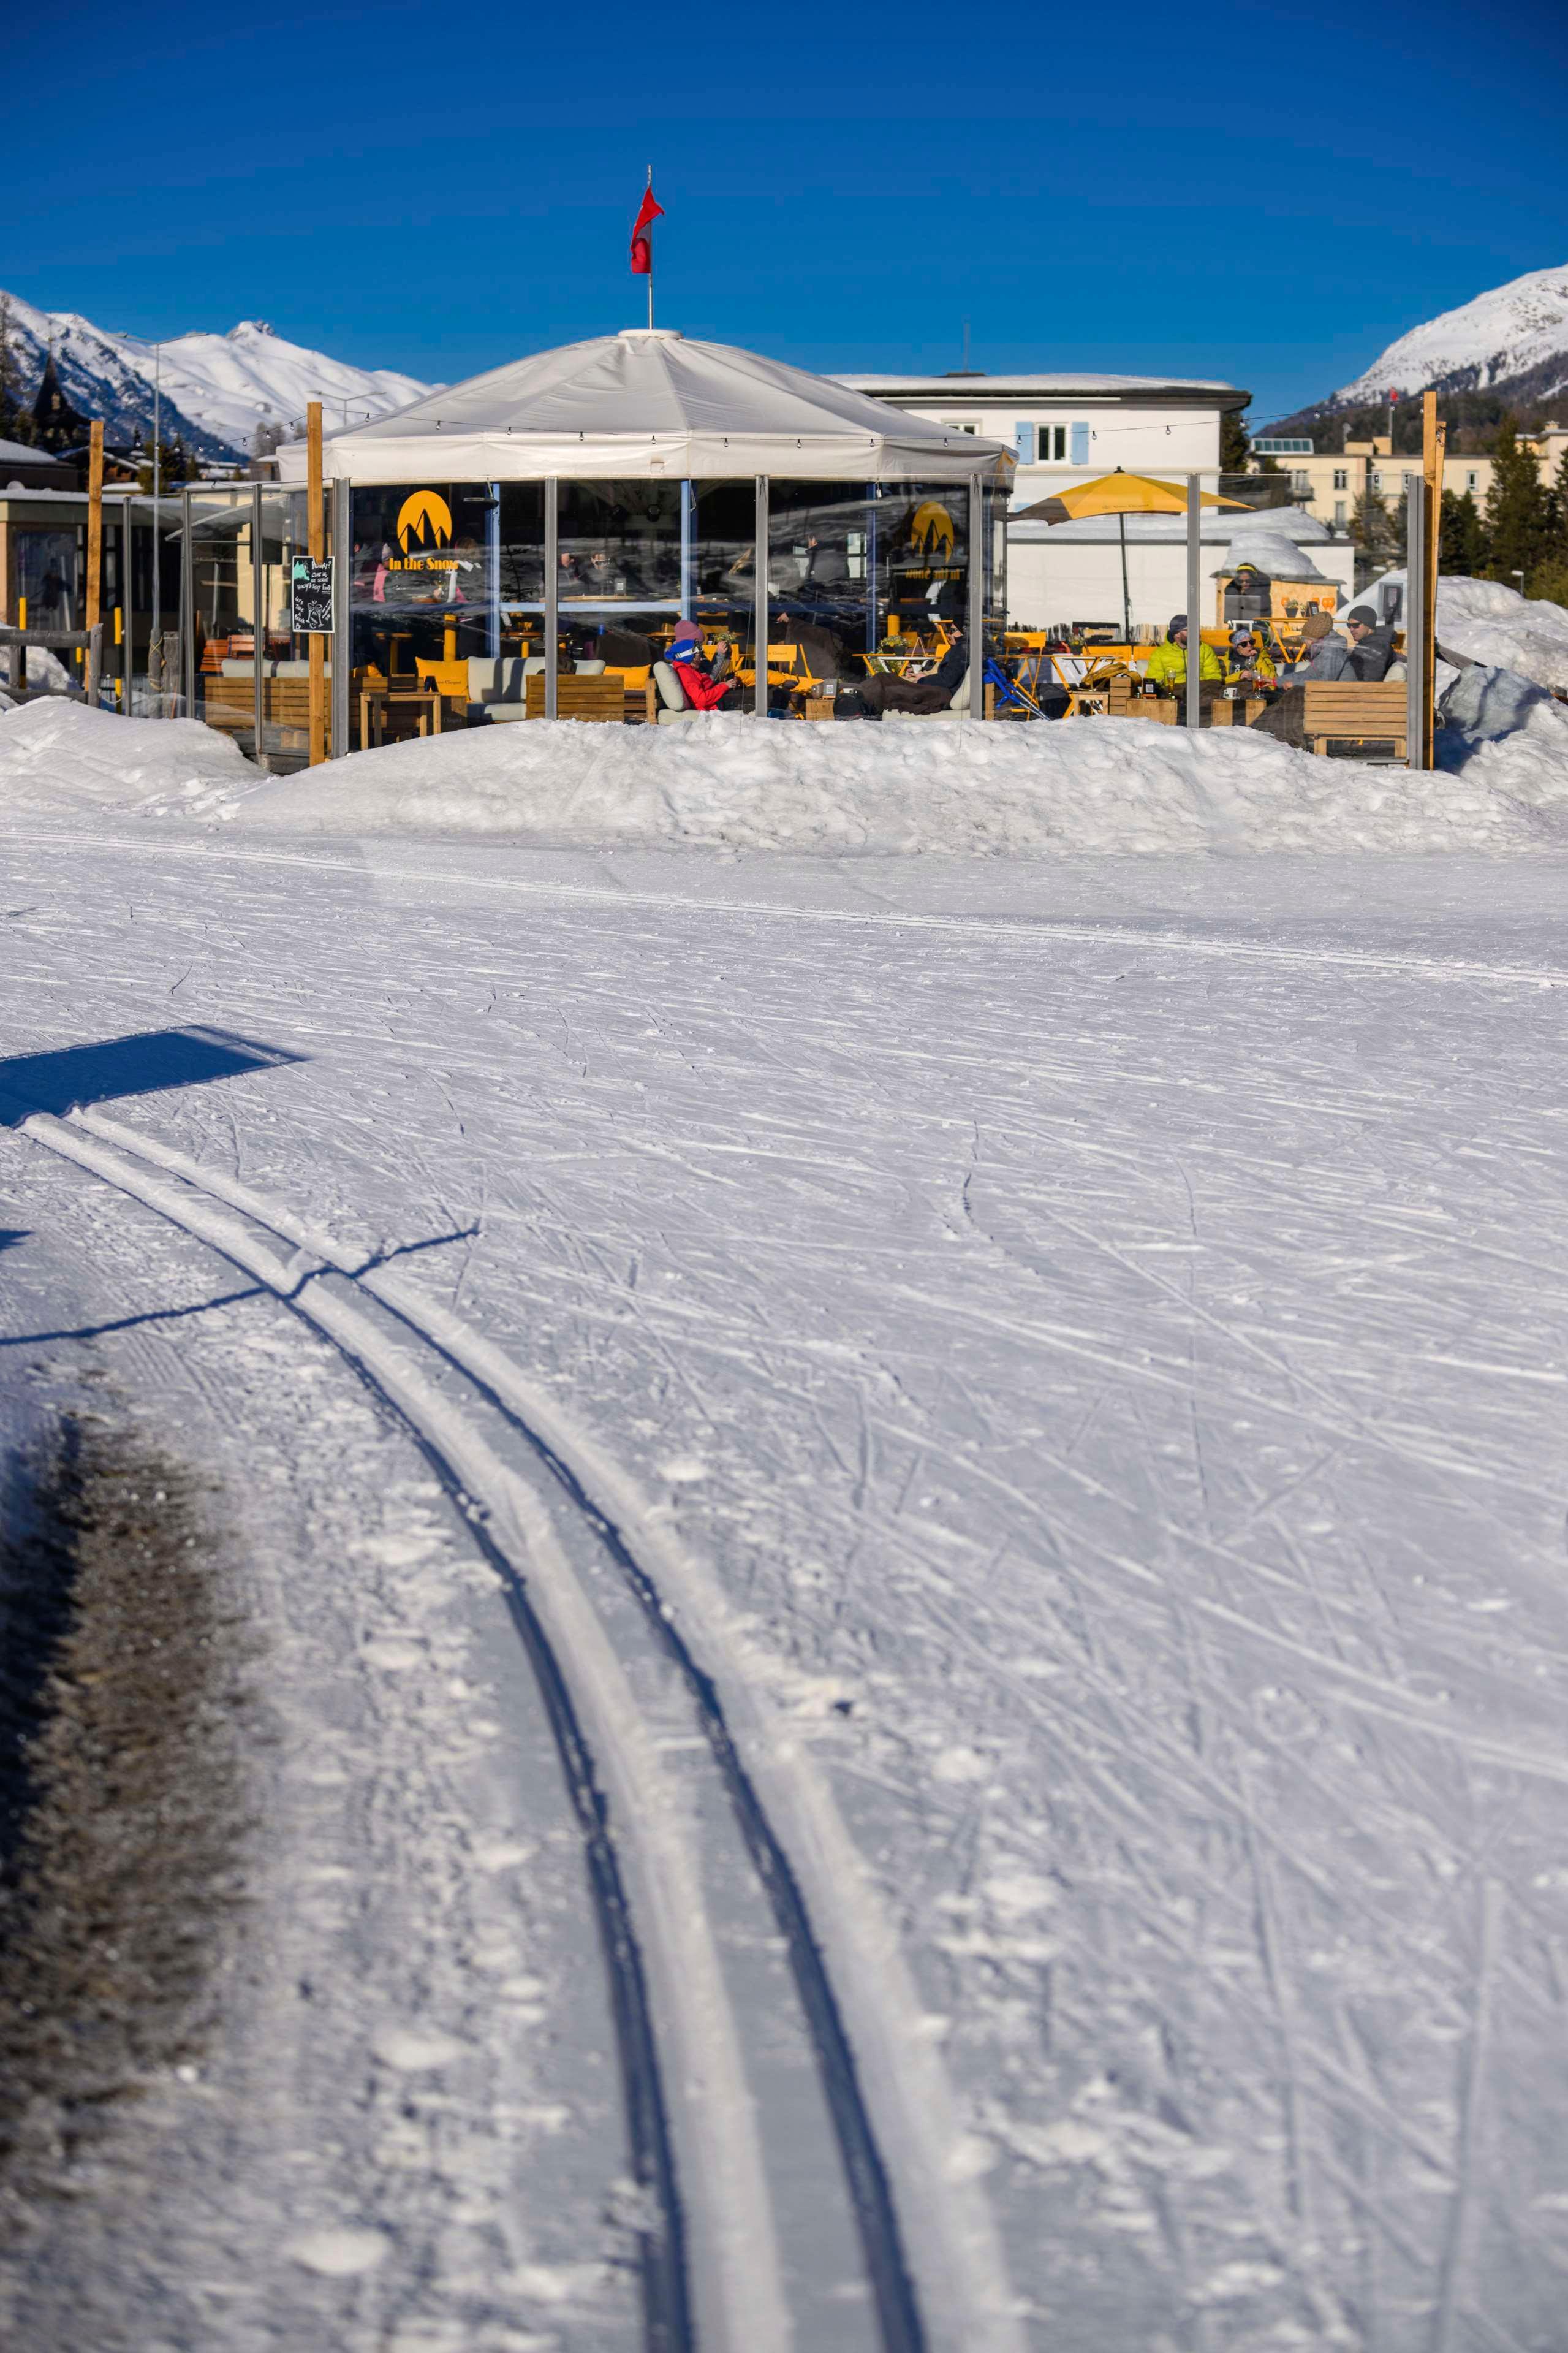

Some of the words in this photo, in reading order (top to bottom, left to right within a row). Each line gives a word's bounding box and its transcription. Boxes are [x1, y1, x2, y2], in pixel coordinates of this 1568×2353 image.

[389, 558, 402, 571] In
[404, 557, 424, 570] the
[426, 557, 458, 570] Snow
